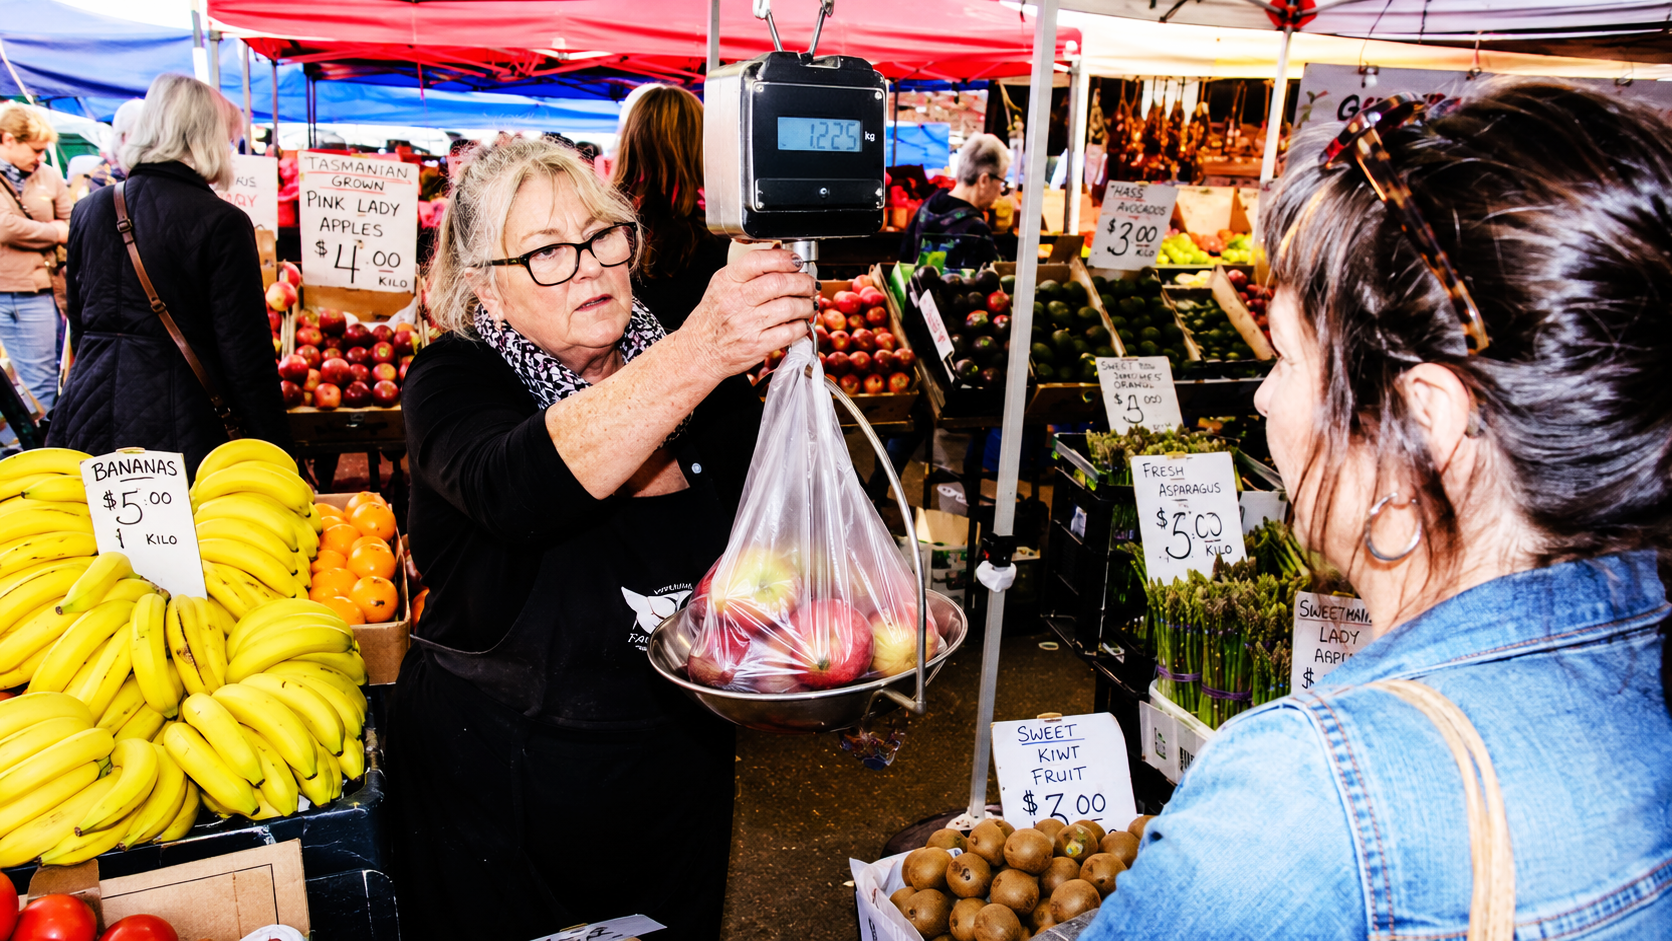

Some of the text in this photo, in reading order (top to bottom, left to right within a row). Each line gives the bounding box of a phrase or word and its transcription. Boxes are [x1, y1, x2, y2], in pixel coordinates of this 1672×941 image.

[864, 131, 876, 142] kg
[304, 156, 409, 179] TASMANIAN
[331, 175, 385, 191] GROWN
[306, 190, 400, 217] PINK LADY
[1116, 201, 1167, 216] AVOCADOS
[319, 217, 384, 238] APPLES
[1135, 249, 1155, 258] KILO
[378, 276, 408, 288] KILO
[91, 458, 178, 482] BANANAS
[1142, 462, 1184, 478] FRESH
[1159, 482, 1222, 497] ASPARAGUS
[146, 533, 178, 545] KILO
[1206, 545, 1233, 557] KILO
[1320, 626, 1360, 645] LADY
[1017, 723, 1078, 743] SWEET
[1031, 765, 1087, 786] FRUIT
